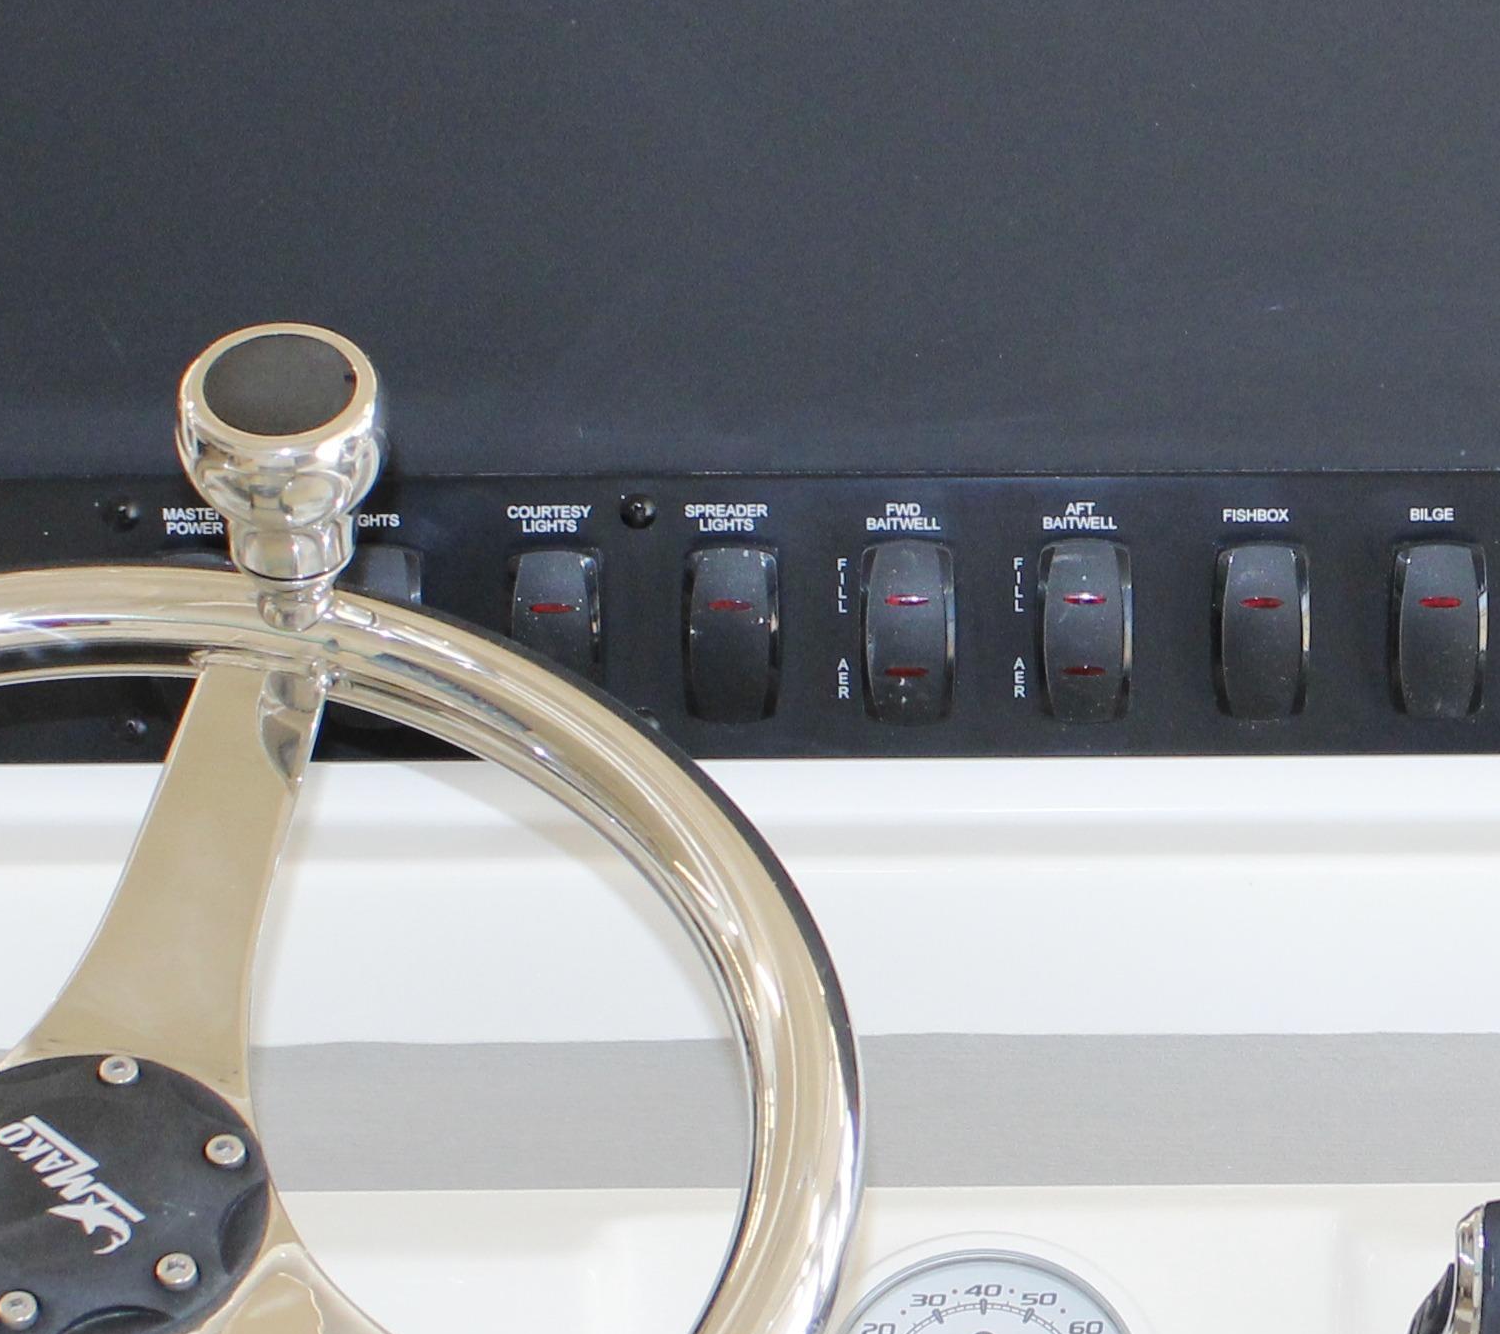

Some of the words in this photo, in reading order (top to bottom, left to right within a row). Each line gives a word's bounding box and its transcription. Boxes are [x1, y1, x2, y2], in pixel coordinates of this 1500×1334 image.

[506, 505, 592, 519] COURTESY
[684, 504, 769, 518] SPREADER
[885, 502, 921, 516] FWD
[1065, 501, 1096, 515] AFT
[1222, 507, 1290, 523] FISHBOX
[1409, 507, 1455, 522] BILGE
[357, 513, 400, 528] GHTS
[522, 519, 578, 533] LIGHTS
[699, 518, 755, 532] LIGHTS
[866, 516, 941, 531] BAITWELL
[1042, 515, 1118, 530] BAITWELL
[166, 522, 224, 535] POWER
[836, 557, 848, 613] FILL
[1012, 556, 1025, 612] FILL
[836, 657, 850, 699] AER
[1012, 656, 1026, 698] AER
[964, 1284, 1002, 1298] 40
[910, 1292, 946, 1308] 30
[1020, 1291, 1058, 1307] 50
